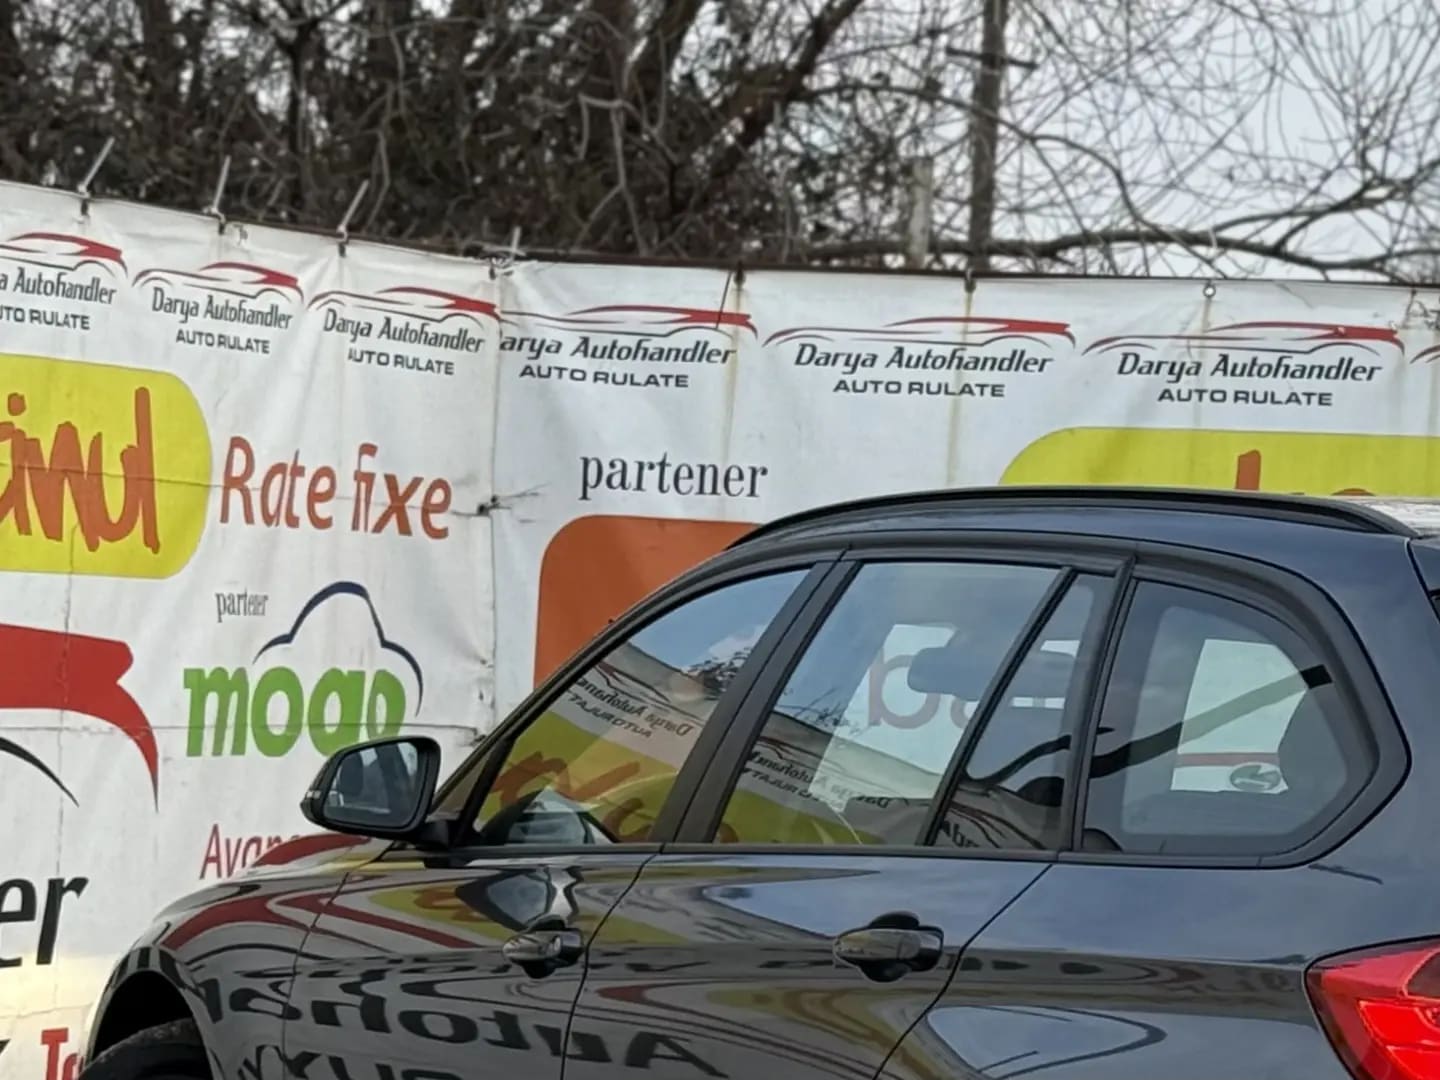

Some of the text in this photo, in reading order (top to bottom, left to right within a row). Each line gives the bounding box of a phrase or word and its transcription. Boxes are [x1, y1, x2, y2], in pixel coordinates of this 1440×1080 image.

[13, 266, 117, 304] Autohandler
[29, 308, 91, 331] RULATE
[152, 287, 293, 330] Darya Autohandler
[175, 329, 271, 355] AUTO RULATE
[323, 308, 486, 354] Darya Autohandler
[393, 354, 455, 375] RULATE
[570, 336, 736, 365] Autohandler
[794, 343, 1053, 374] Darya Autohandler
[519, 363, 689, 389] AUTO RULATE
[1116, 352, 1383, 383] Darya Autohandler
[832, 377, 1006, 399] AUTO RULATE
[1157, 388, 1333, 407] AUTO RULATE
[220, 435, 453, 541] Rate fixe
[578, 451, 769, 499] partener
[215, 587, 269, 623] partener
